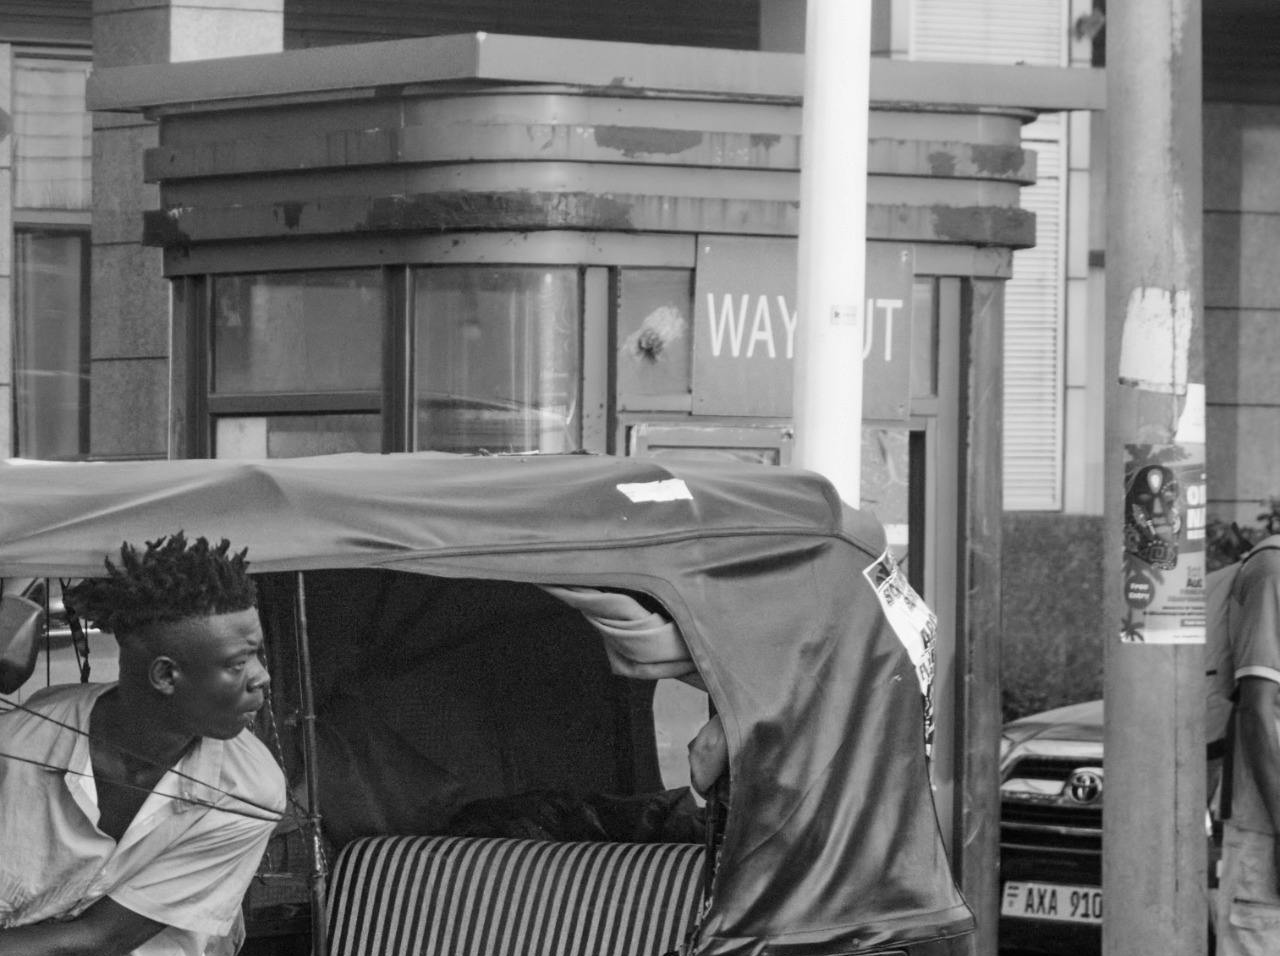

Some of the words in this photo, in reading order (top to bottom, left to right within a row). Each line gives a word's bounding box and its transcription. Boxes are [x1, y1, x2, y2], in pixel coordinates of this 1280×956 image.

[707, 293, 797, 359] WAY
[1024, 887, 1058, 916] AXA
[1070, 890, 1103, 919] 910
